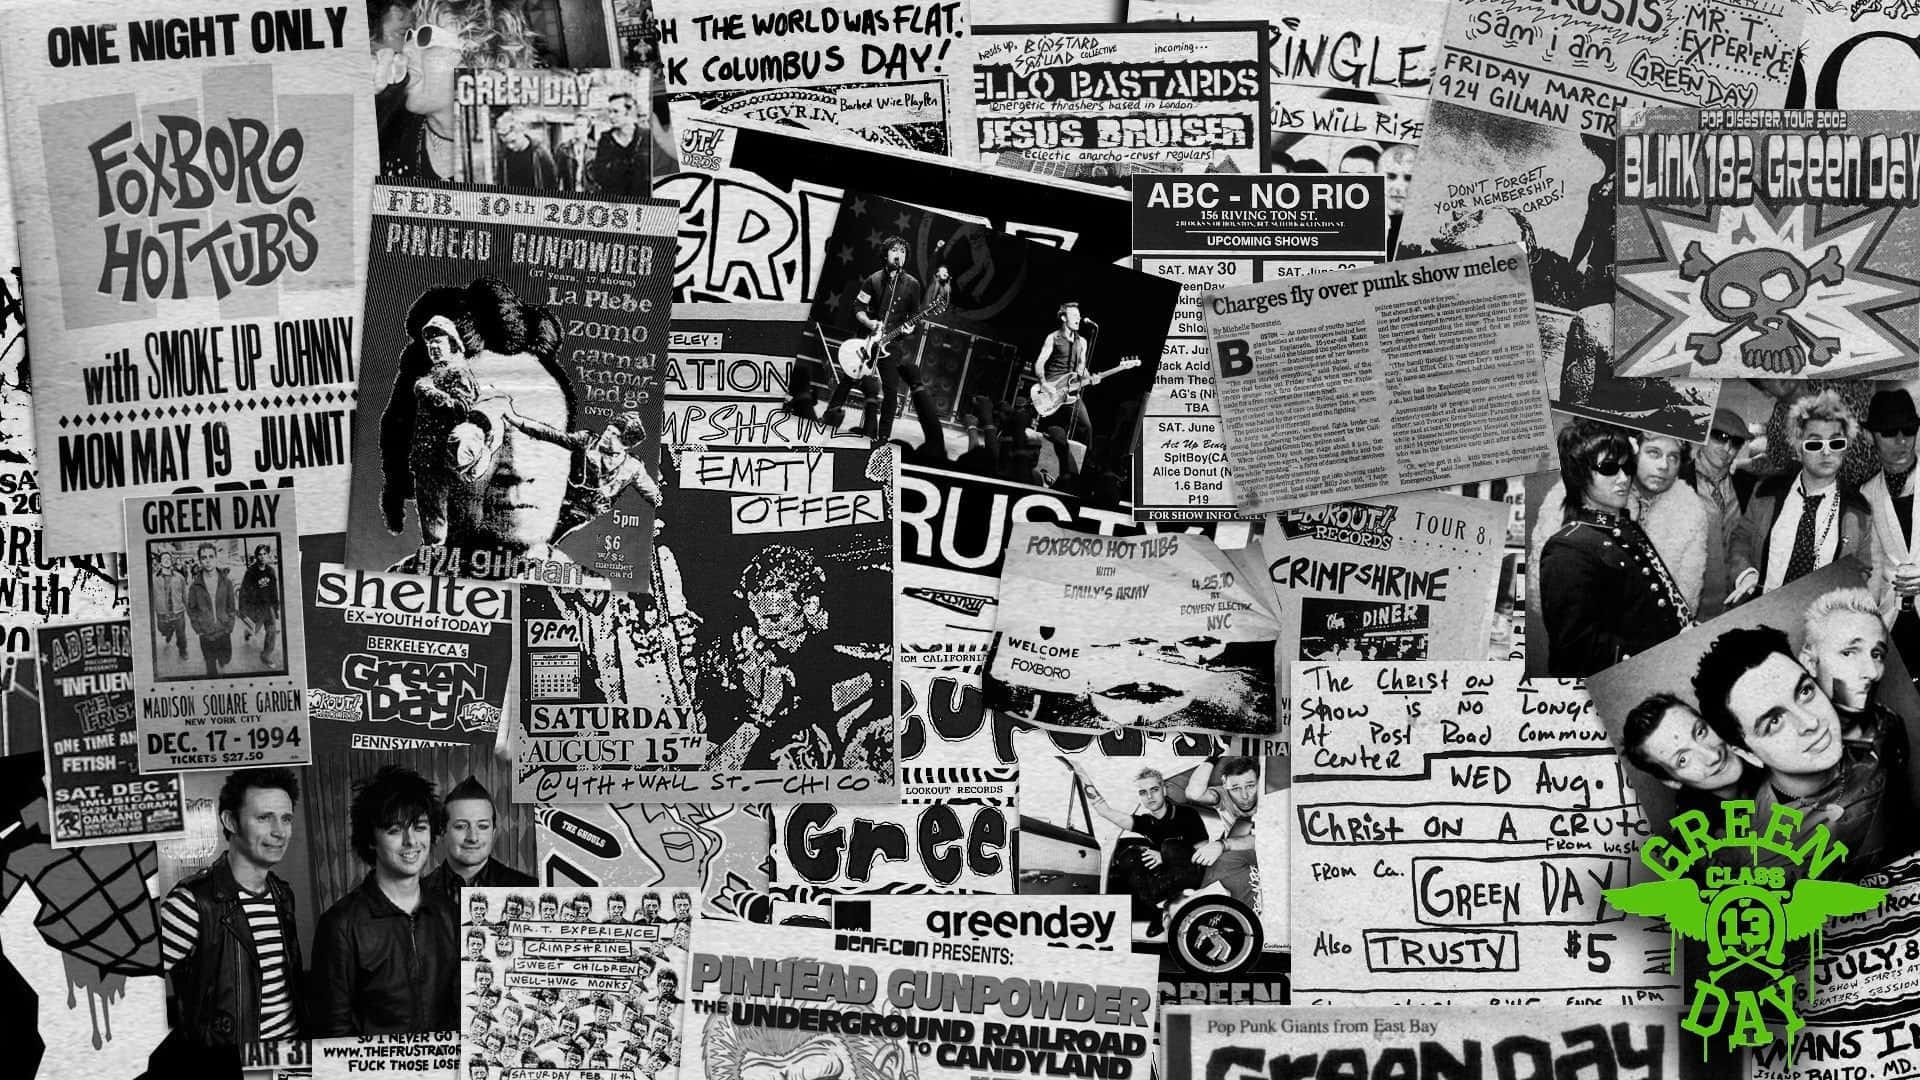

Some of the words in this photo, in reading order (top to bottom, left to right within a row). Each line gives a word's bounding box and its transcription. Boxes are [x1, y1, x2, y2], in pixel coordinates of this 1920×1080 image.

[48, 24, 120, 67] ONE
[128, 14, 240, 62] NIGHT
[251, 6, 348, 53] ONLY
[693, 15, 746, 41] THE
[752, 8, 840, 36] WORLD
[702, 46, 845, 82] COLUMBUS
[862, 39, 951, 79] DAY!
[1155, 44, 1209, 55] incoming...
[457, 74, 541, 106] GREEN
[544, 74, 593, 106] DAY
[1071, 69, 1259, 98] BASTARDS
[1444, 53, 1530, 89] FRIDAY
[1545, 80, 1628, 111] MARCH
[1630, 53, 1704, 92] GREEN
[1706, 80, 1756, 107] DAY
[992, 101, 1045, 113] energetic
[1051, 100, 1104, 111] thrashers
[1109, 100, 1141, 111] based
[1144, 101, 1156, 110] in
[1159, 101, 1193, 110] London
[1440, 75, 1478, 100] 924
[1490, 89, 1569, 124] GILMAN
[1701, 112, 1724, 128] POP
[1783, 111, 1814, 128] TOUR
[1816, 111, 1848, 128] 2002
[979, 119, 1085, 149] JESUS
[1097, 118, 1246, 147] BRUISER
[88, 115, 304, 217] FOXBORO
[1024, 151, 1071, 161] eclectic
[1079, 151, 1160, 162] anarcho-crust
[1166, 150, 1212, 161] regulars
[1705, 134, 1754, 200] 182
[1448, 178, 1488, 198] DON'T
[1495, 165, 1547, 189] FORGET
[1147, 182, 1220, 209] ABC
[1251, 183, 1300, 209] NO
[1312, 183, 1370, 209] RIO
[1434, 200, 1466, 214] YOUR
[1473, 178, 1554, 207] MEMBERSHIP
[1523, 181, 1566, 214] CARDS!
[387, 190, 462, 217] FEB.
[544, 204, 643, 233] 2008!
[1201, 211, 1218, 220] 156
[1222, 211, 1267, 220] RIVING
[1270, 211, 1297, 220] TON
[98, 218, 200, 302] HOT
[186, 197, 319, 301] TUBS
[386, 223, 491, 261] PINHEAD
[512, 232, 653, 276] GUNPOWDER
[1207, 236, 1272, 247] UPCOMING
[1275, 236, 1319, 247] SHOWS
[1158, 265, 1182, 275] SAT.
[1188, 264, 1214, 275] MAY
[1217, 262, 1236, 275] 30
[547, 287, 578, 306] La
[1212, 292, 1287, 315] Charges
[1291, 285, 1315, 306] fly
[1319, 279, 1360, 299] over
[1363, 270, 1410, 297] punk
[1412, 266, 1460, 286] show
[1463, 256, 1518, 278] melee
[83, 348, 139, 405] with
[145, 327, 228, 399] SMOKE
[232, 324, 262, 390] UP
[271, 316, 355, 387] JOHNNY
[1185, 403, 1209, 413] TBA
[1158, 423, 1185, 432] SAT.
[1188, 423, 1215, 433] June
[59, 430, 125, 492] MON
[131, 424, 191, 485] MAY
[202, 422, 232, 477] 19
[696, 452, 822, 494] EMPTY
[1153, 467, 1181, 477] Alice
[1183, 467, 1217, 477] Donut
[1194, 481, 1223, 490] Band
[737, 495, 879, 527] OFFER
[1189, 495, 1209, 504] P19
[142, 497, 222, 534] GREEN
[234, 494, 280, 529] DAY
[612, 509, 640, 527] 5pm
[1150, 511, 1169, 520] FOR
[1171, 511, 1203, 520] SHOW
[1206, 511, 1231, 520] INFO
[604, 535, 620, 550] $6
[1027, 535, 1102, 556] FOXBORO
[1104, 538, 1139, 559] HOT
[1140, 535, 1179, 559] TUBS
[1315, 527, 1392, 550] RECORDS
[416, 544, 461, 578] 924
[472, 546, 584, 587] gilman
[1269, 555, 1449, 602] CRIMPSHRINE
[1115, 584, 1149, 600] ARMY
[346, 610, 422, 627] EX-YOUTH
[1207, 614, 1233, 631] NYC
[1362, 604, 1419, 628] DINER
[1008, 636, 1080, 659] WELCOME
[1010, 658, 1071, 680] FOXBORO
[1303, 665, 1353, 692] The
[143, 694, 195, 720] MADISON
[202, 691, 249, 717] SQUARE
[256, 688, 302, 714] GARDEN
[185, 717, 206, 726] NEW
[211, 716, 236, 726] YORK
[240, 714, 262, 724] CITY
[534, 707, 693, 731] SATURDAY
[147, 731, 199, 755] DEC.
[206, 730, 228, 751] 17
[248, 726, 301, 750] 1994
[1441, 721, 1492, 746] Road
[170, 753, 217, 764] TICKETS
[222, 752, 264, 763] $27.50
[529, 738, 634, 763] AUGUST
[646, 735, 702, 763] 15TH
[639, 774, 699, 792] WALL
[906, 786, 951, 795] LOOKOUT
[957, 785, 1003, 794] RECORDS
[1451, 764, 1511, 794] WED
[562, 821, 576, 834] THE
[577, 828, 607, 848] GHOULS
[1424, 817, 1464, 837] ON
[1420, 866, 1521, 922] GREEN
[1541, 861, 1614, 922] DAY
[560, 925, 656, 939] EXPERIENCE
[527, 943, 630, 955] CRIMPSHRINE
[932, 944, 1015, 966] PRESENTS:
[1370, 935, 1506, 967] TRUSTY
[1565, 930, 1617, 974] $5
[573, 962, 636, 975] CHILDREN
[1814, 942, 1903, 986] JULY,
[510, 976, 578, 987] WELL-HUNG
[588, 978, 630, 990] MONKS
[691, 952, 878, 1005] PINHEAD
[887, 968, 1151, 1027] GUNPOWDER
[1829, 980, 1859, 992] SHOW
[1864, 970, 1903, 984] STARTS
[692, 1000, 729, 1017] THE
[732, 1003, 975, 1045] UNDERGROUND
[983, 1022, 1147, 1058] RAILROAD
[1208, 1019, 1236, 1037] Pop
[1240, 1019, 1277, 1034] Punk
[1280, 1019, 1329, 1034] Giants
[1333, 1019, 1368, 1033] from
[1374, 1019, 1404, 1034] East
[1409, 1019, 1438, 1036] Bay
[349, 1060, 385, 1072] FUCK
[390, 1059, 429, 1071] THOSE
[936, 1044, 1134, 1080] CANDYLAND
[1883, 1059, 1917, 1077] MD.
